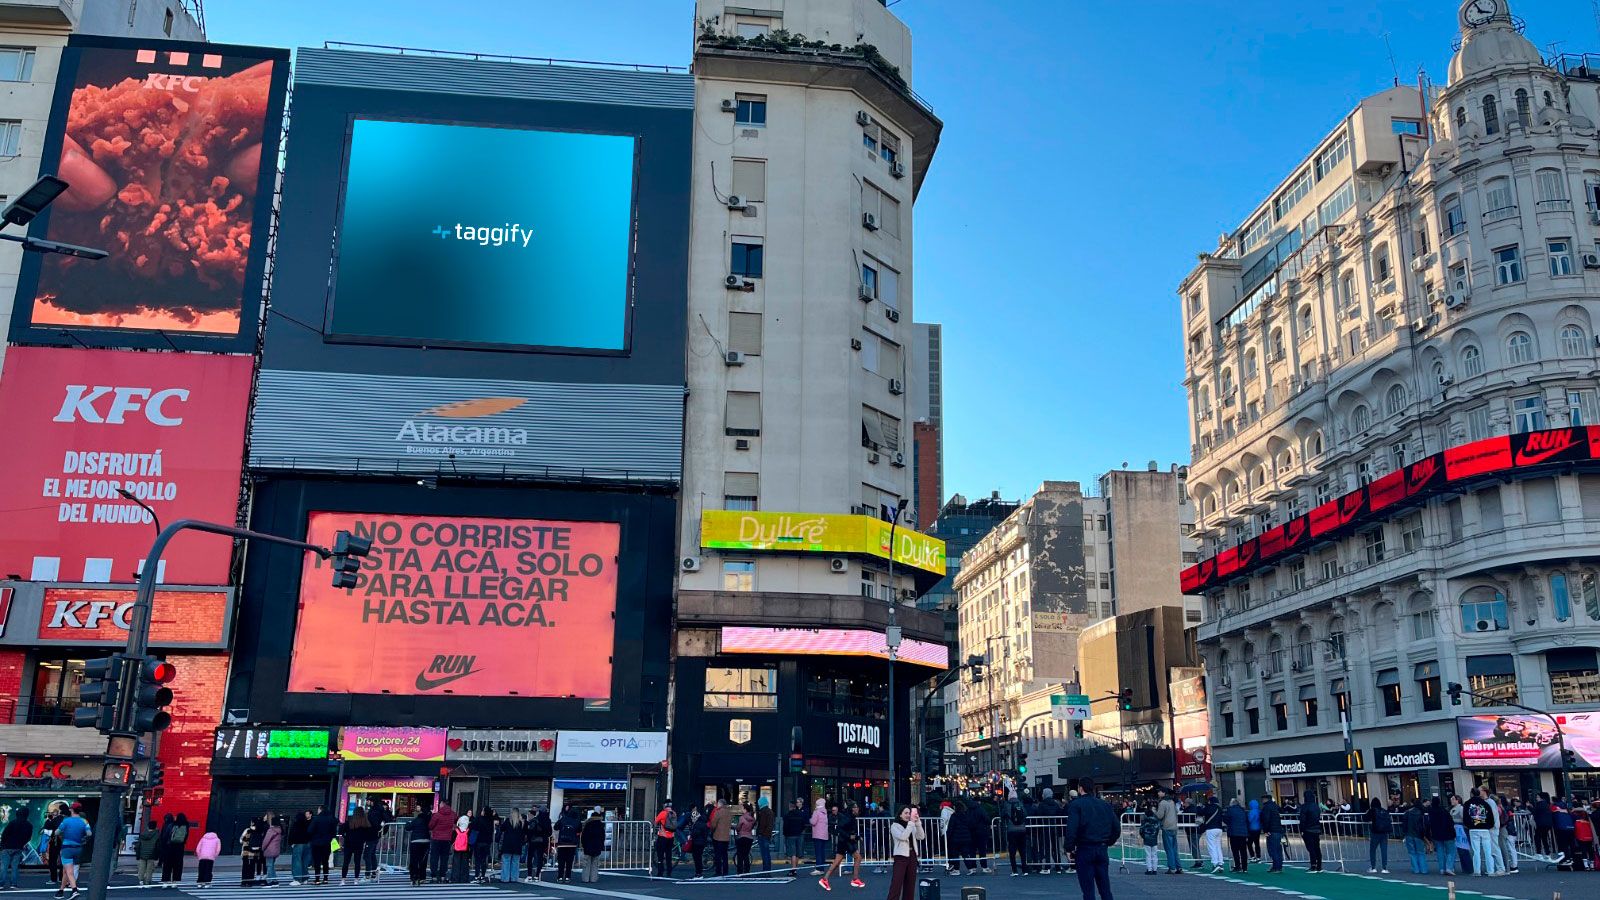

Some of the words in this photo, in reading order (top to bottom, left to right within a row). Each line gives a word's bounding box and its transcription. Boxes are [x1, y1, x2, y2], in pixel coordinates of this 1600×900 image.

[143, 73, 203, 92] KFC
[455, 223, 533, 247] taggify
[53, 385, 189, 426] KFC
[396, 420, 527, 445] Atacama
[1525, 428, 1572, 452] RUN
[406, 445, 440, 454] Buenos
[470, 448, 515, 456] Argentina
[63, 449, 162, 477] DISFRUTÁ
[43, 478, 61, 497] EL
[65, 479, 120, 499] MEJOR
[124, 481, 177, 501] POLLO
[58, 503, 88, 523] DEL
[92, 504, 155, 525] MUNDO
[353, 521, 403, 545] NO
[411, 523, 571, 550] CORRISTE
[431, 546, 508, 579] ACÁ,
[516, 553, 603, 577] SOLO
[444, 575, 569, 601] LLEGAR
[47, 600, 135, 630] KFC
[362, 600, 471, 626] HASTA
[478, 597, 555, 627] ACÁ.
[428, 655, 476, 674] RUN
[356, 736, 405, 746] Drugstores
[406, 736, 421, 746] 24
[463, 740, 494, 752] LOVE
[497, 740, 538, 752] CHUKA
[837, 722, 880, 748] TOSTADO
[10, 759, 73, 779] KFC
[1181, 764, 1205, 776] MOSTAZA
[1270, 761, 1306, 774] McDonald's
[1384, 752, 1435, 767] McDonald's
[355, 780, 386, 788] Internet
[394, 780, 429, 788] Locutorio
[588, 782, 628, 790] OPTICA
